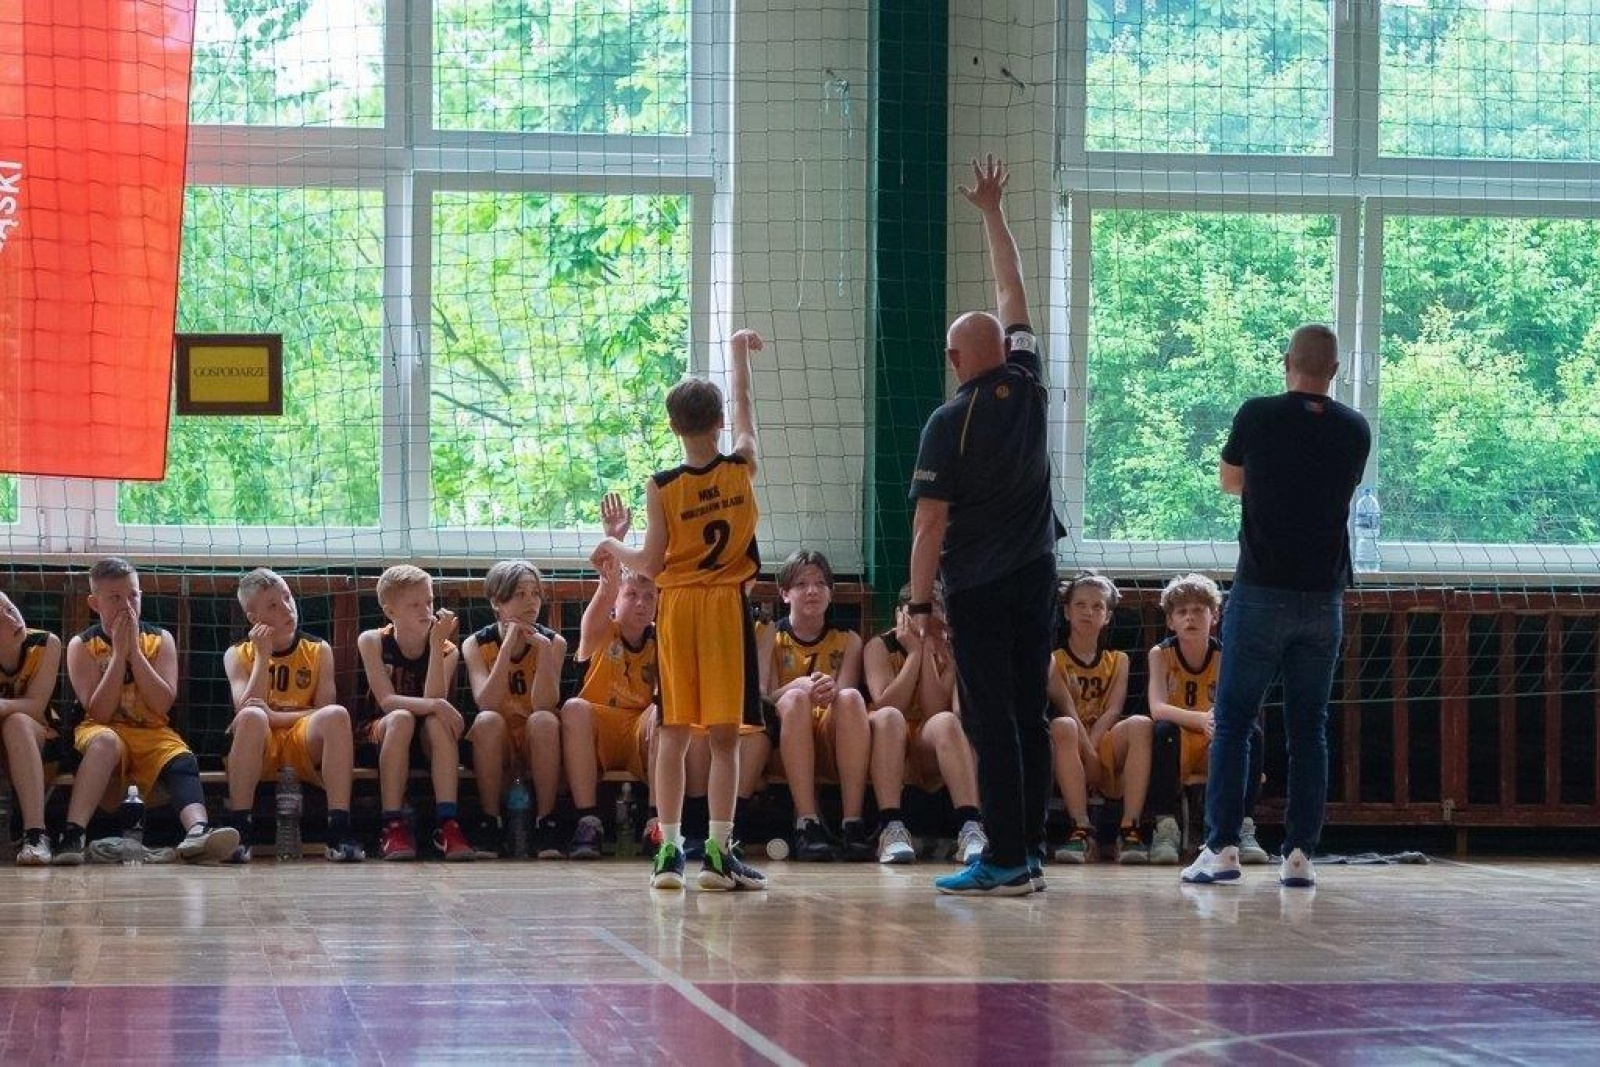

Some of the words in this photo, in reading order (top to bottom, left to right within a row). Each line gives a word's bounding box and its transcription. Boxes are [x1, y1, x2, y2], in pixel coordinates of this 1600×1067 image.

[698, 519, 731, 570] 2
[269, 664, 289, 692] 10
[1077, 676, 1105, 701] 23
[1185, 680, 1198, 707] 8
